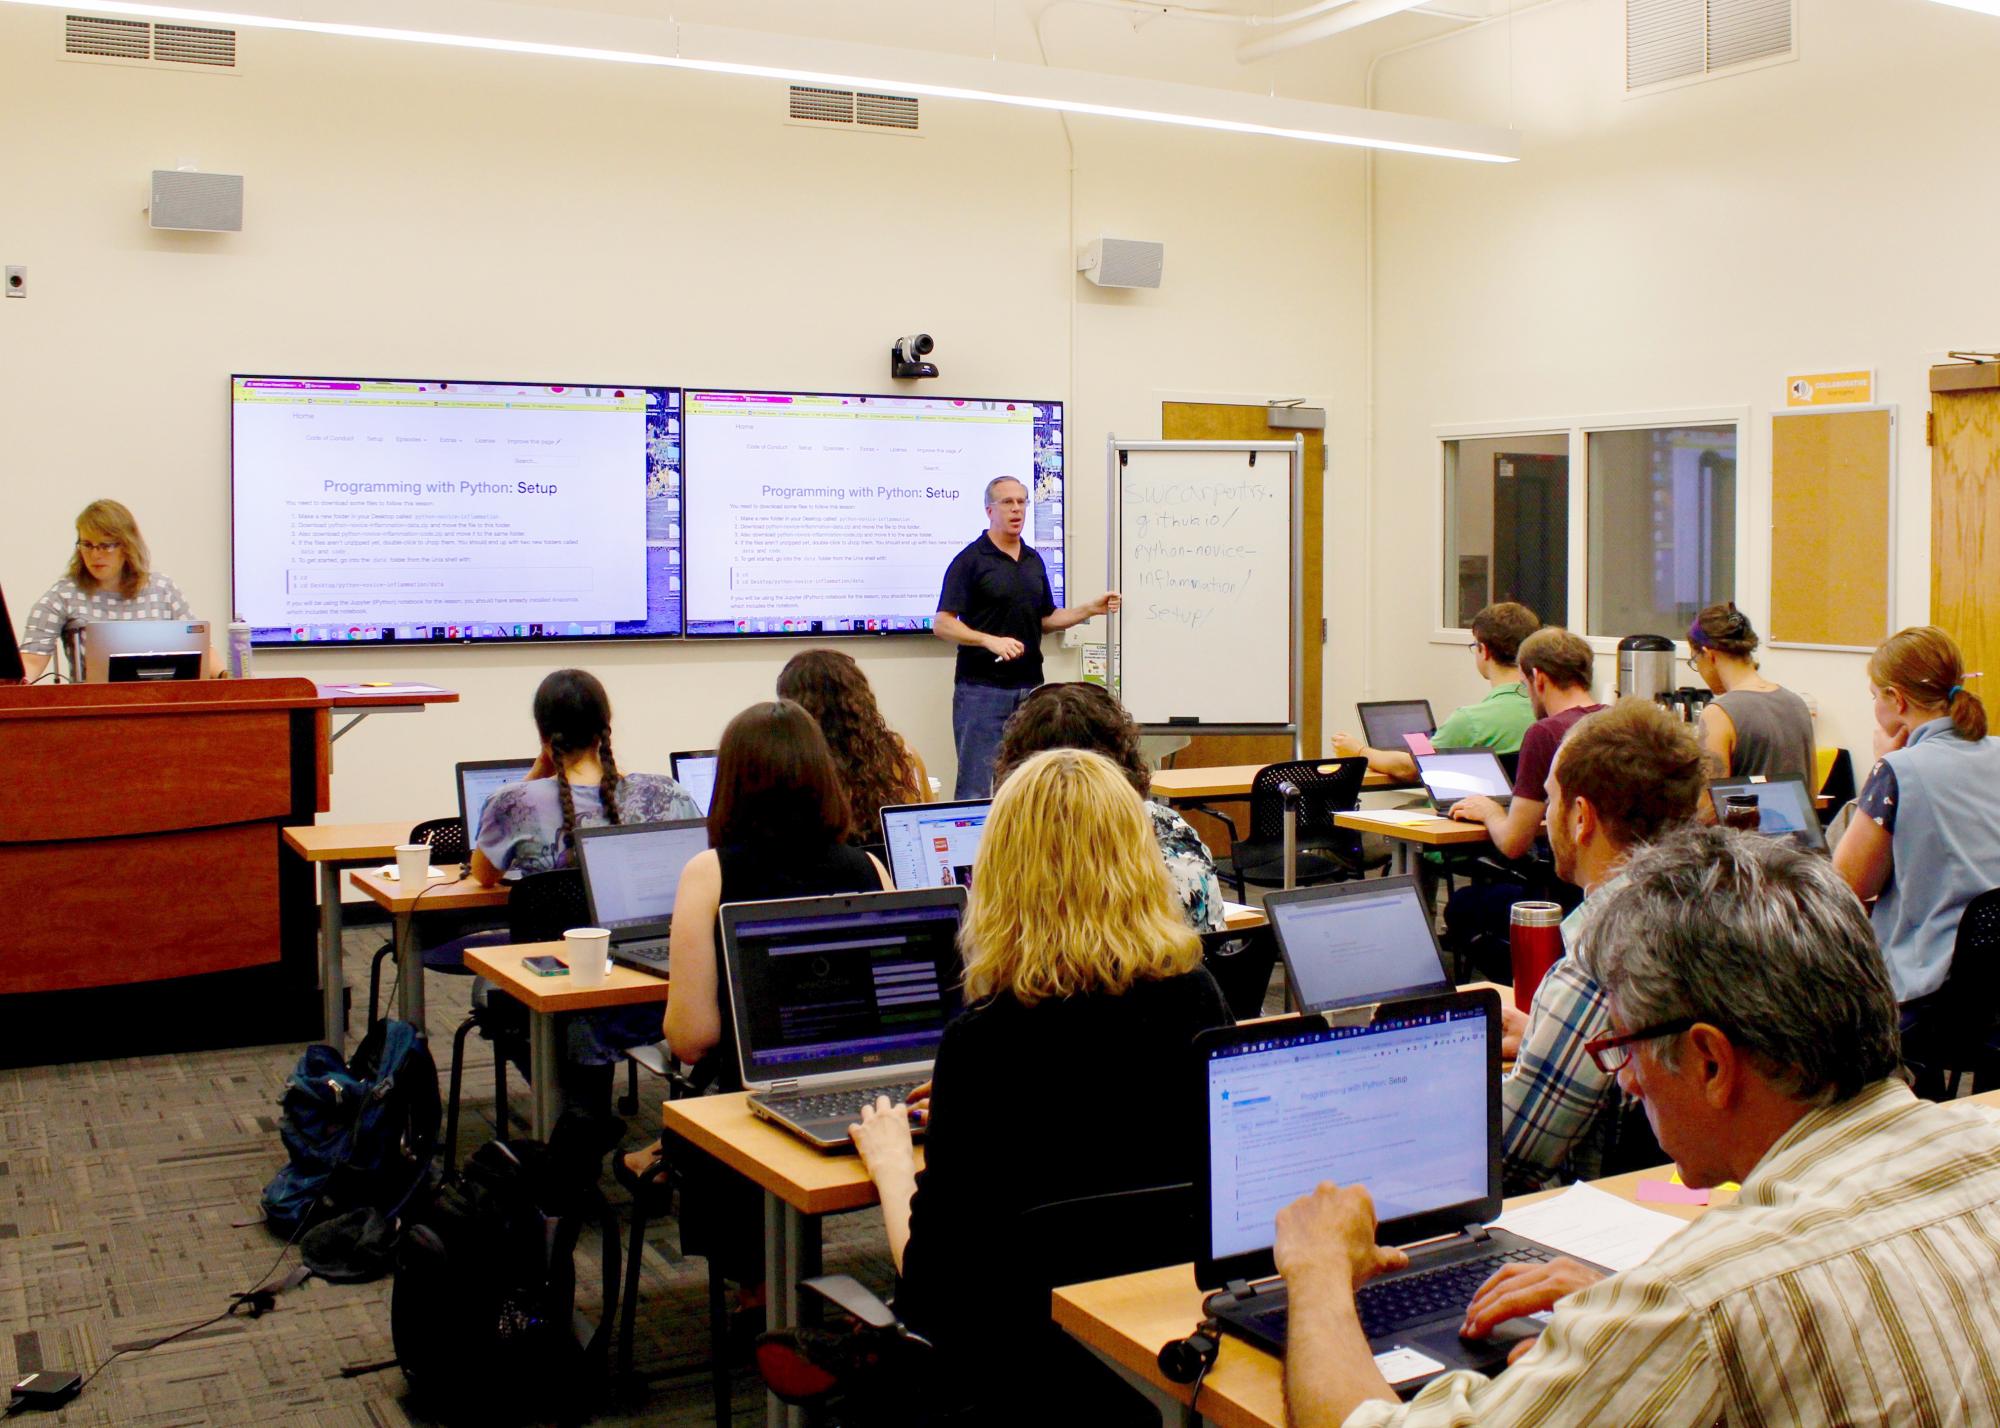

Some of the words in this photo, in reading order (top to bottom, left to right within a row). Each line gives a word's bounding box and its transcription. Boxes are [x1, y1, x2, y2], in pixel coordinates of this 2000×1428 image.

[292, 411, 314, 419] Home
[735, 423, 754, 431] Home
[324, 480, 422, 496] Programming
[426, 481, 455, 493] with
[460, 481, 513, 496] Python:
[517, 482, 558, 496] Setup
[762, 485, 845, 500] Programming
[848, 486, 874, 498] with
[877, 486, 922, 500] Python:
[926, 487, 960, 500] Setup
